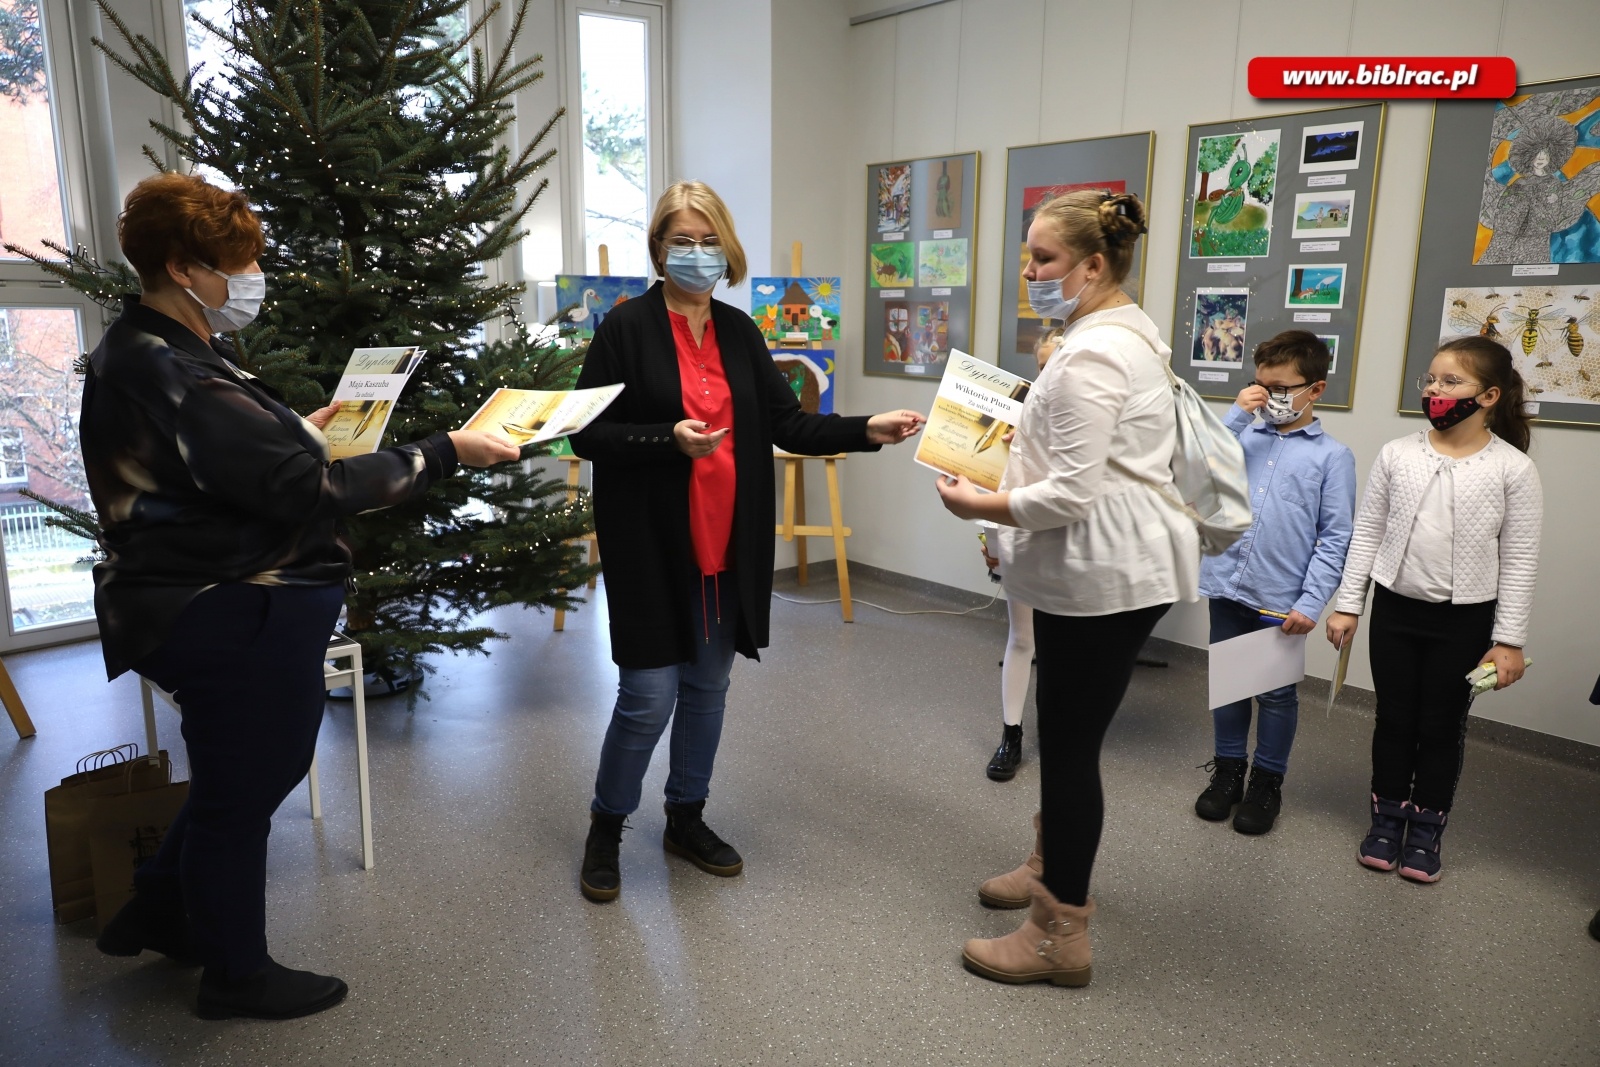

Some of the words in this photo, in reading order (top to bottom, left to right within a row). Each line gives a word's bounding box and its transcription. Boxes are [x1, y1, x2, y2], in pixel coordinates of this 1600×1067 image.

[355, 353, 397, 370] Dyplom
[958, 360, 1011, 389] Dyplom
[348, 380, 363, 389] Maja
[364, 380, 390, 388] Kaszuba
[955, 382, 989, 402] Wiktoria
[967, 399, 976, 407] Za
